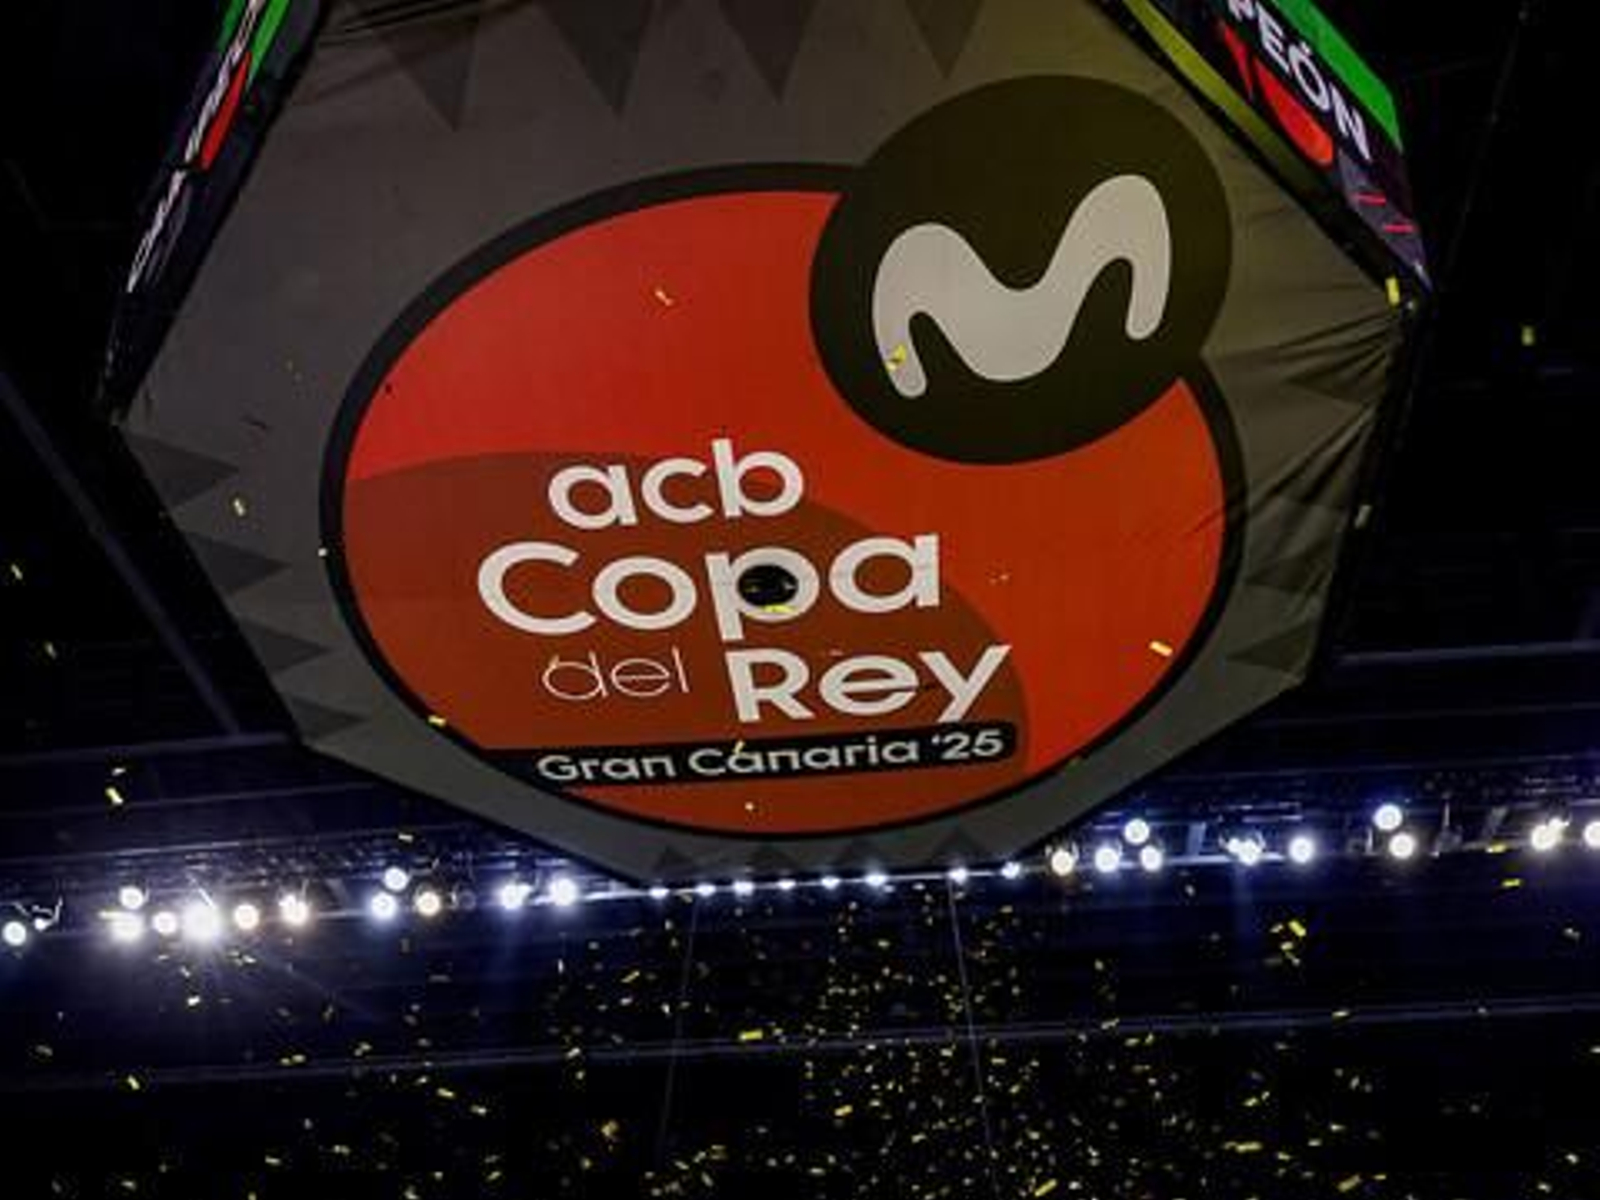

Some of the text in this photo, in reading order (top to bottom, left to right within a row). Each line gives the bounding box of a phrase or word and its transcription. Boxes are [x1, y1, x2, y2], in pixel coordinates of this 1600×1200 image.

[547, 438, 804, 530] acb
[477, 533, 941, 641] Copa
[541, 644, 1012, 723] del Rey
[537, 752, 677, 782] Gran
[688, 735, 920, 776] Canaria
